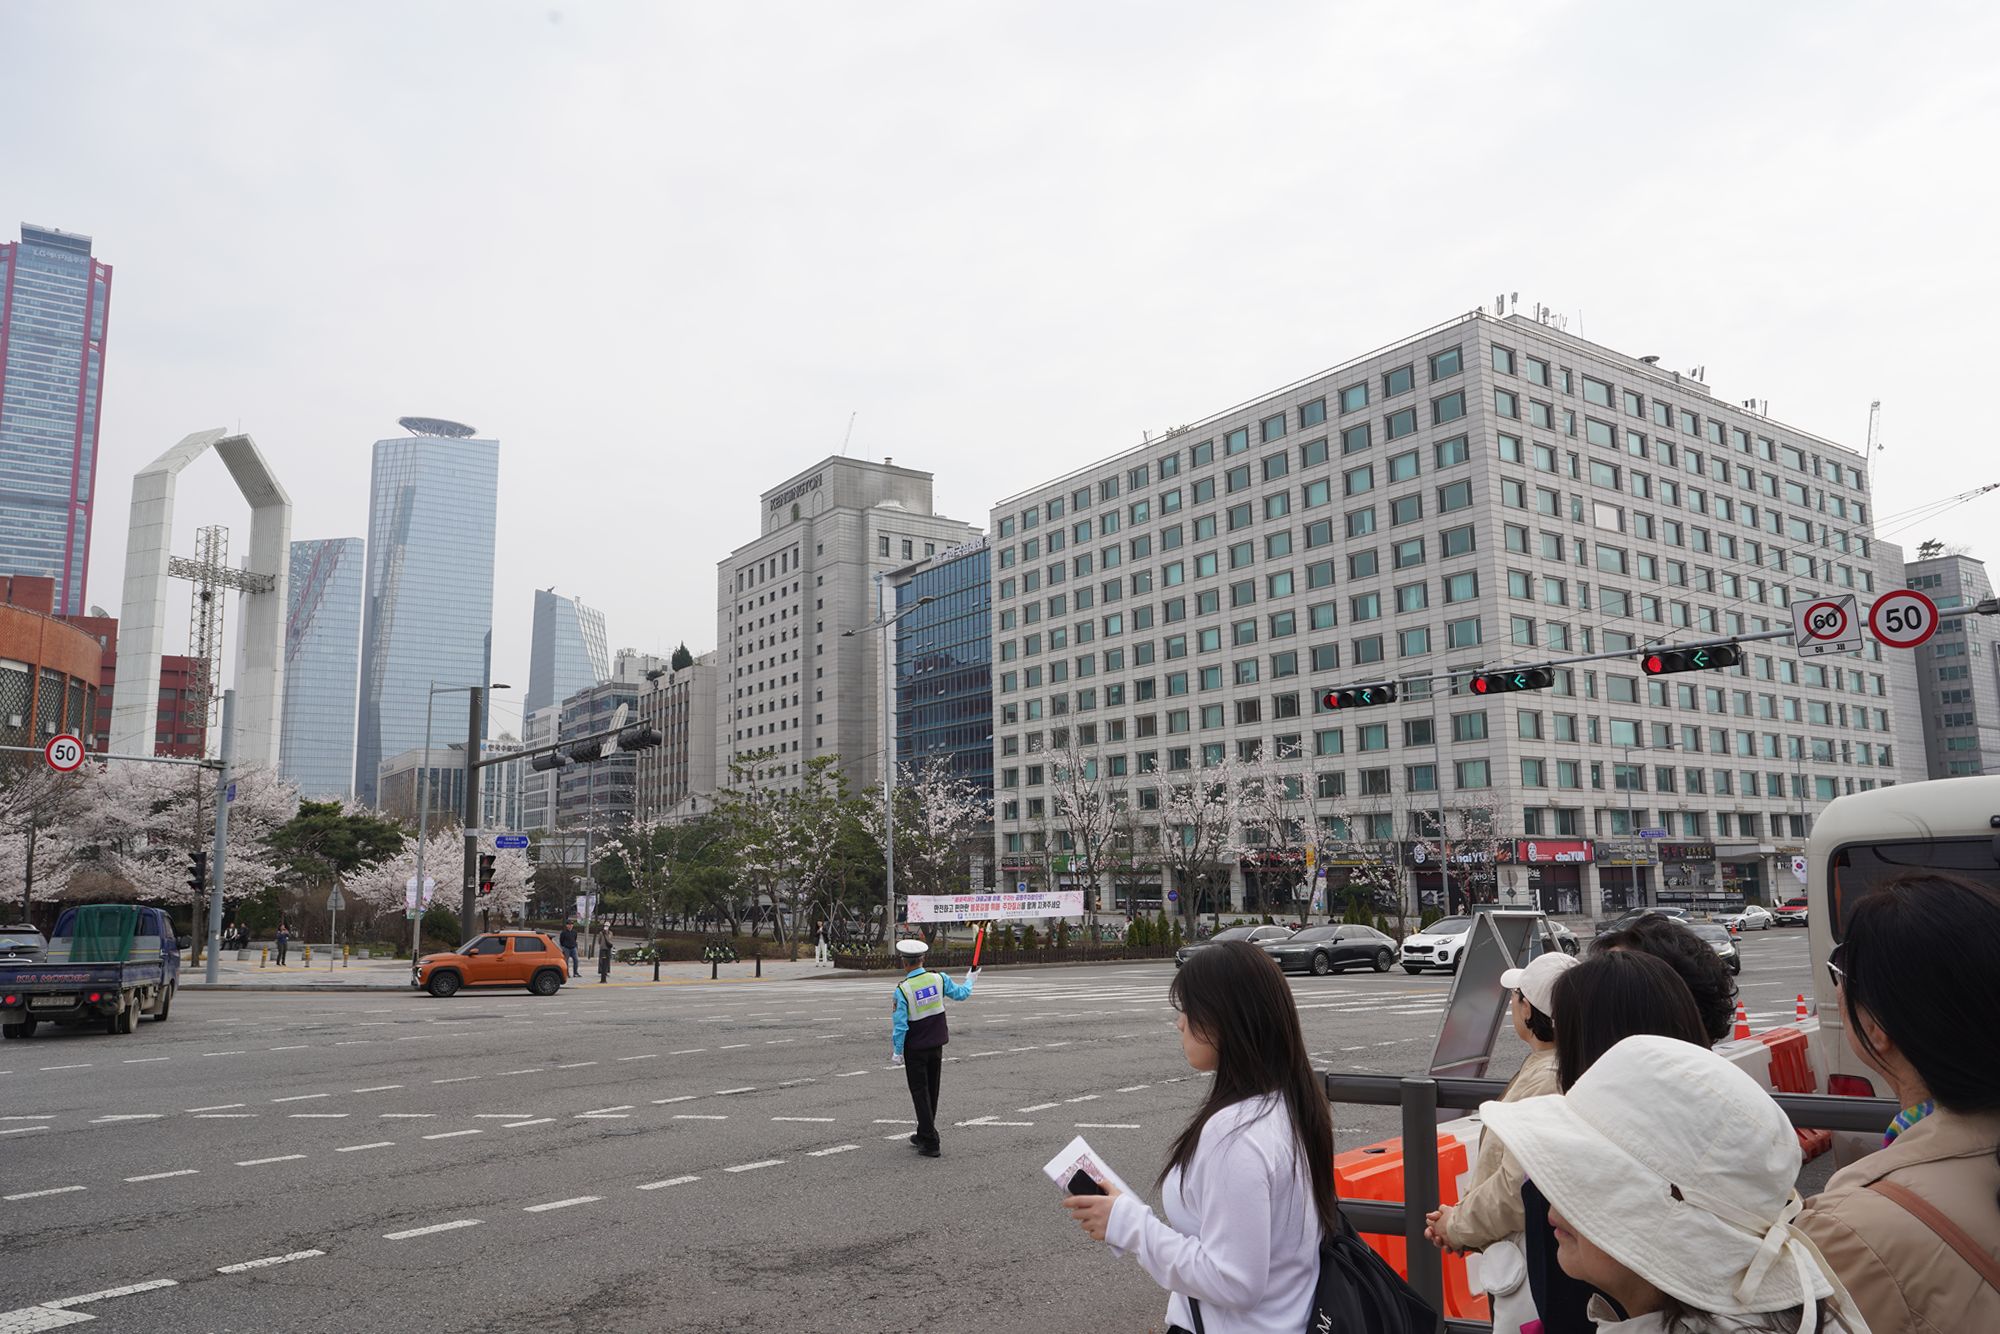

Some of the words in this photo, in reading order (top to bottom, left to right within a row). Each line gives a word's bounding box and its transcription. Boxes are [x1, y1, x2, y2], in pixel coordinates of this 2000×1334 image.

[770, 472, 823, 511] KENSINGTON
[1813, 612, 1838, 629] 60
[1886, 605, 1922, 633] 50
[55, 744, 76, 762] 50
[934, 904, 954, 914] 안전하고
